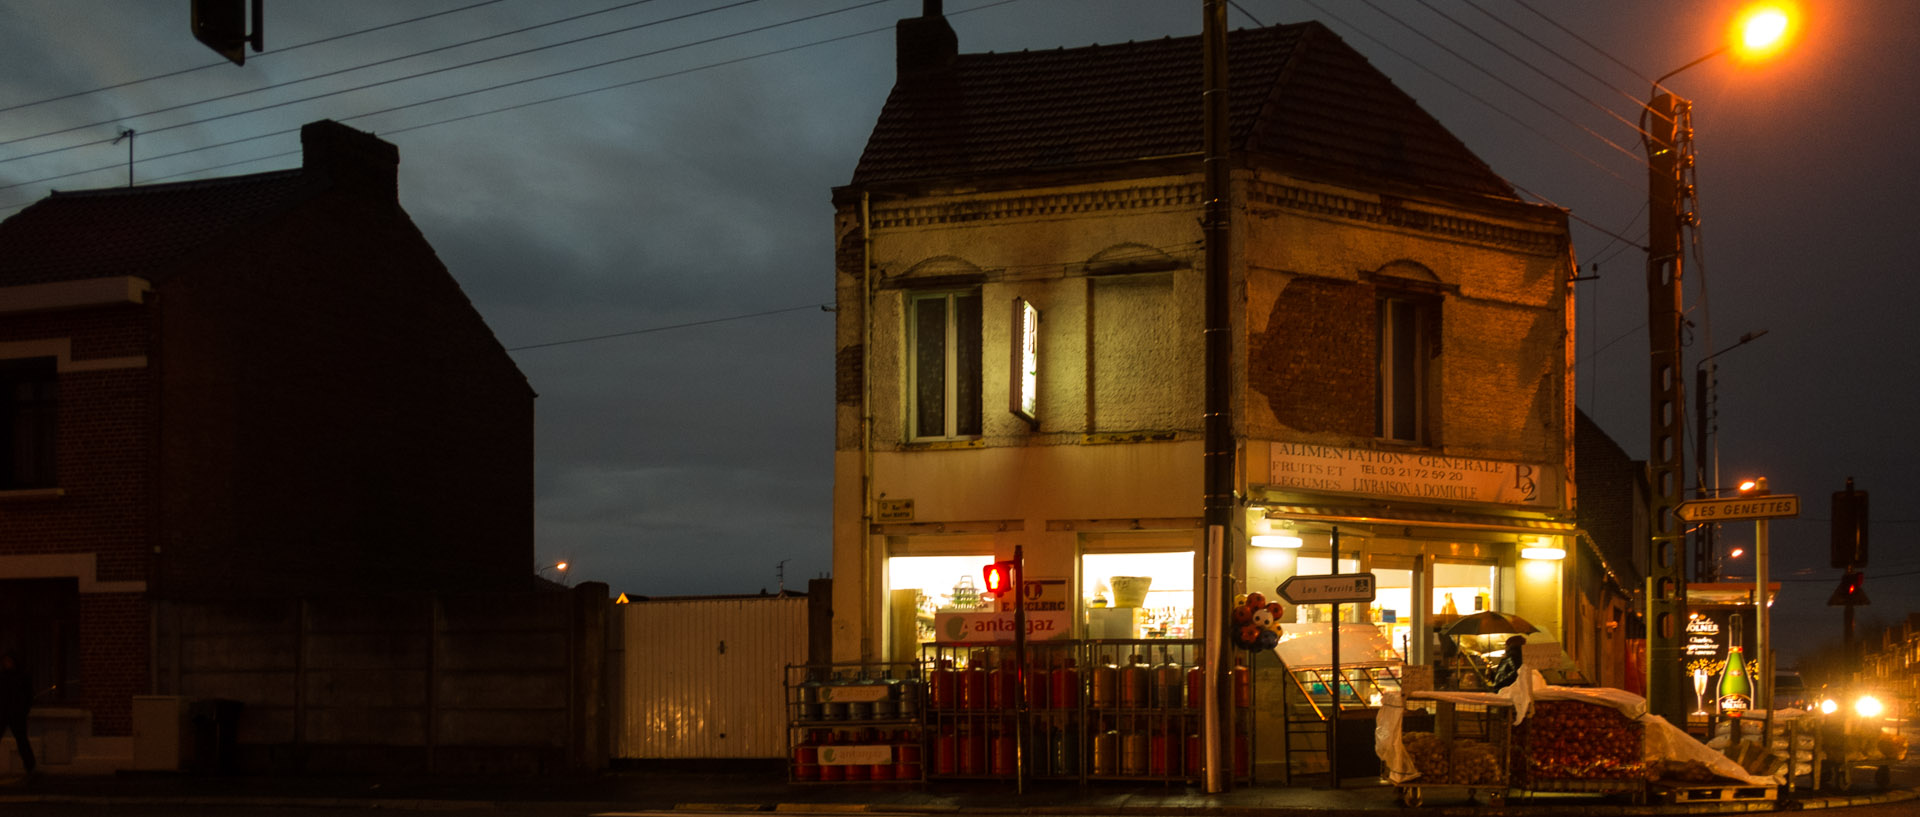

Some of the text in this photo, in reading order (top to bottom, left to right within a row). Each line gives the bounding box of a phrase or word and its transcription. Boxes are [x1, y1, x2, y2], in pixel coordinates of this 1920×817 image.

[1279, 442, 1504, 474] ALIMENTATION GENERALE
[1271, 460, 1346, 477] FRUITS ET
[1360, 464, 1463, 481] TEL 03 21 72 59 20
[1271, 474, 1342, 490] LEGUMES
[1352, 477, 1410, 497] LIVRAISON
[1423, 483, 1479, 500] DOMICILE
[1693, 501, 1791, 517] LES GENETTES
[1301, 586, 1317, 594] Les
[974, 618, 1055, 635] antagaz
